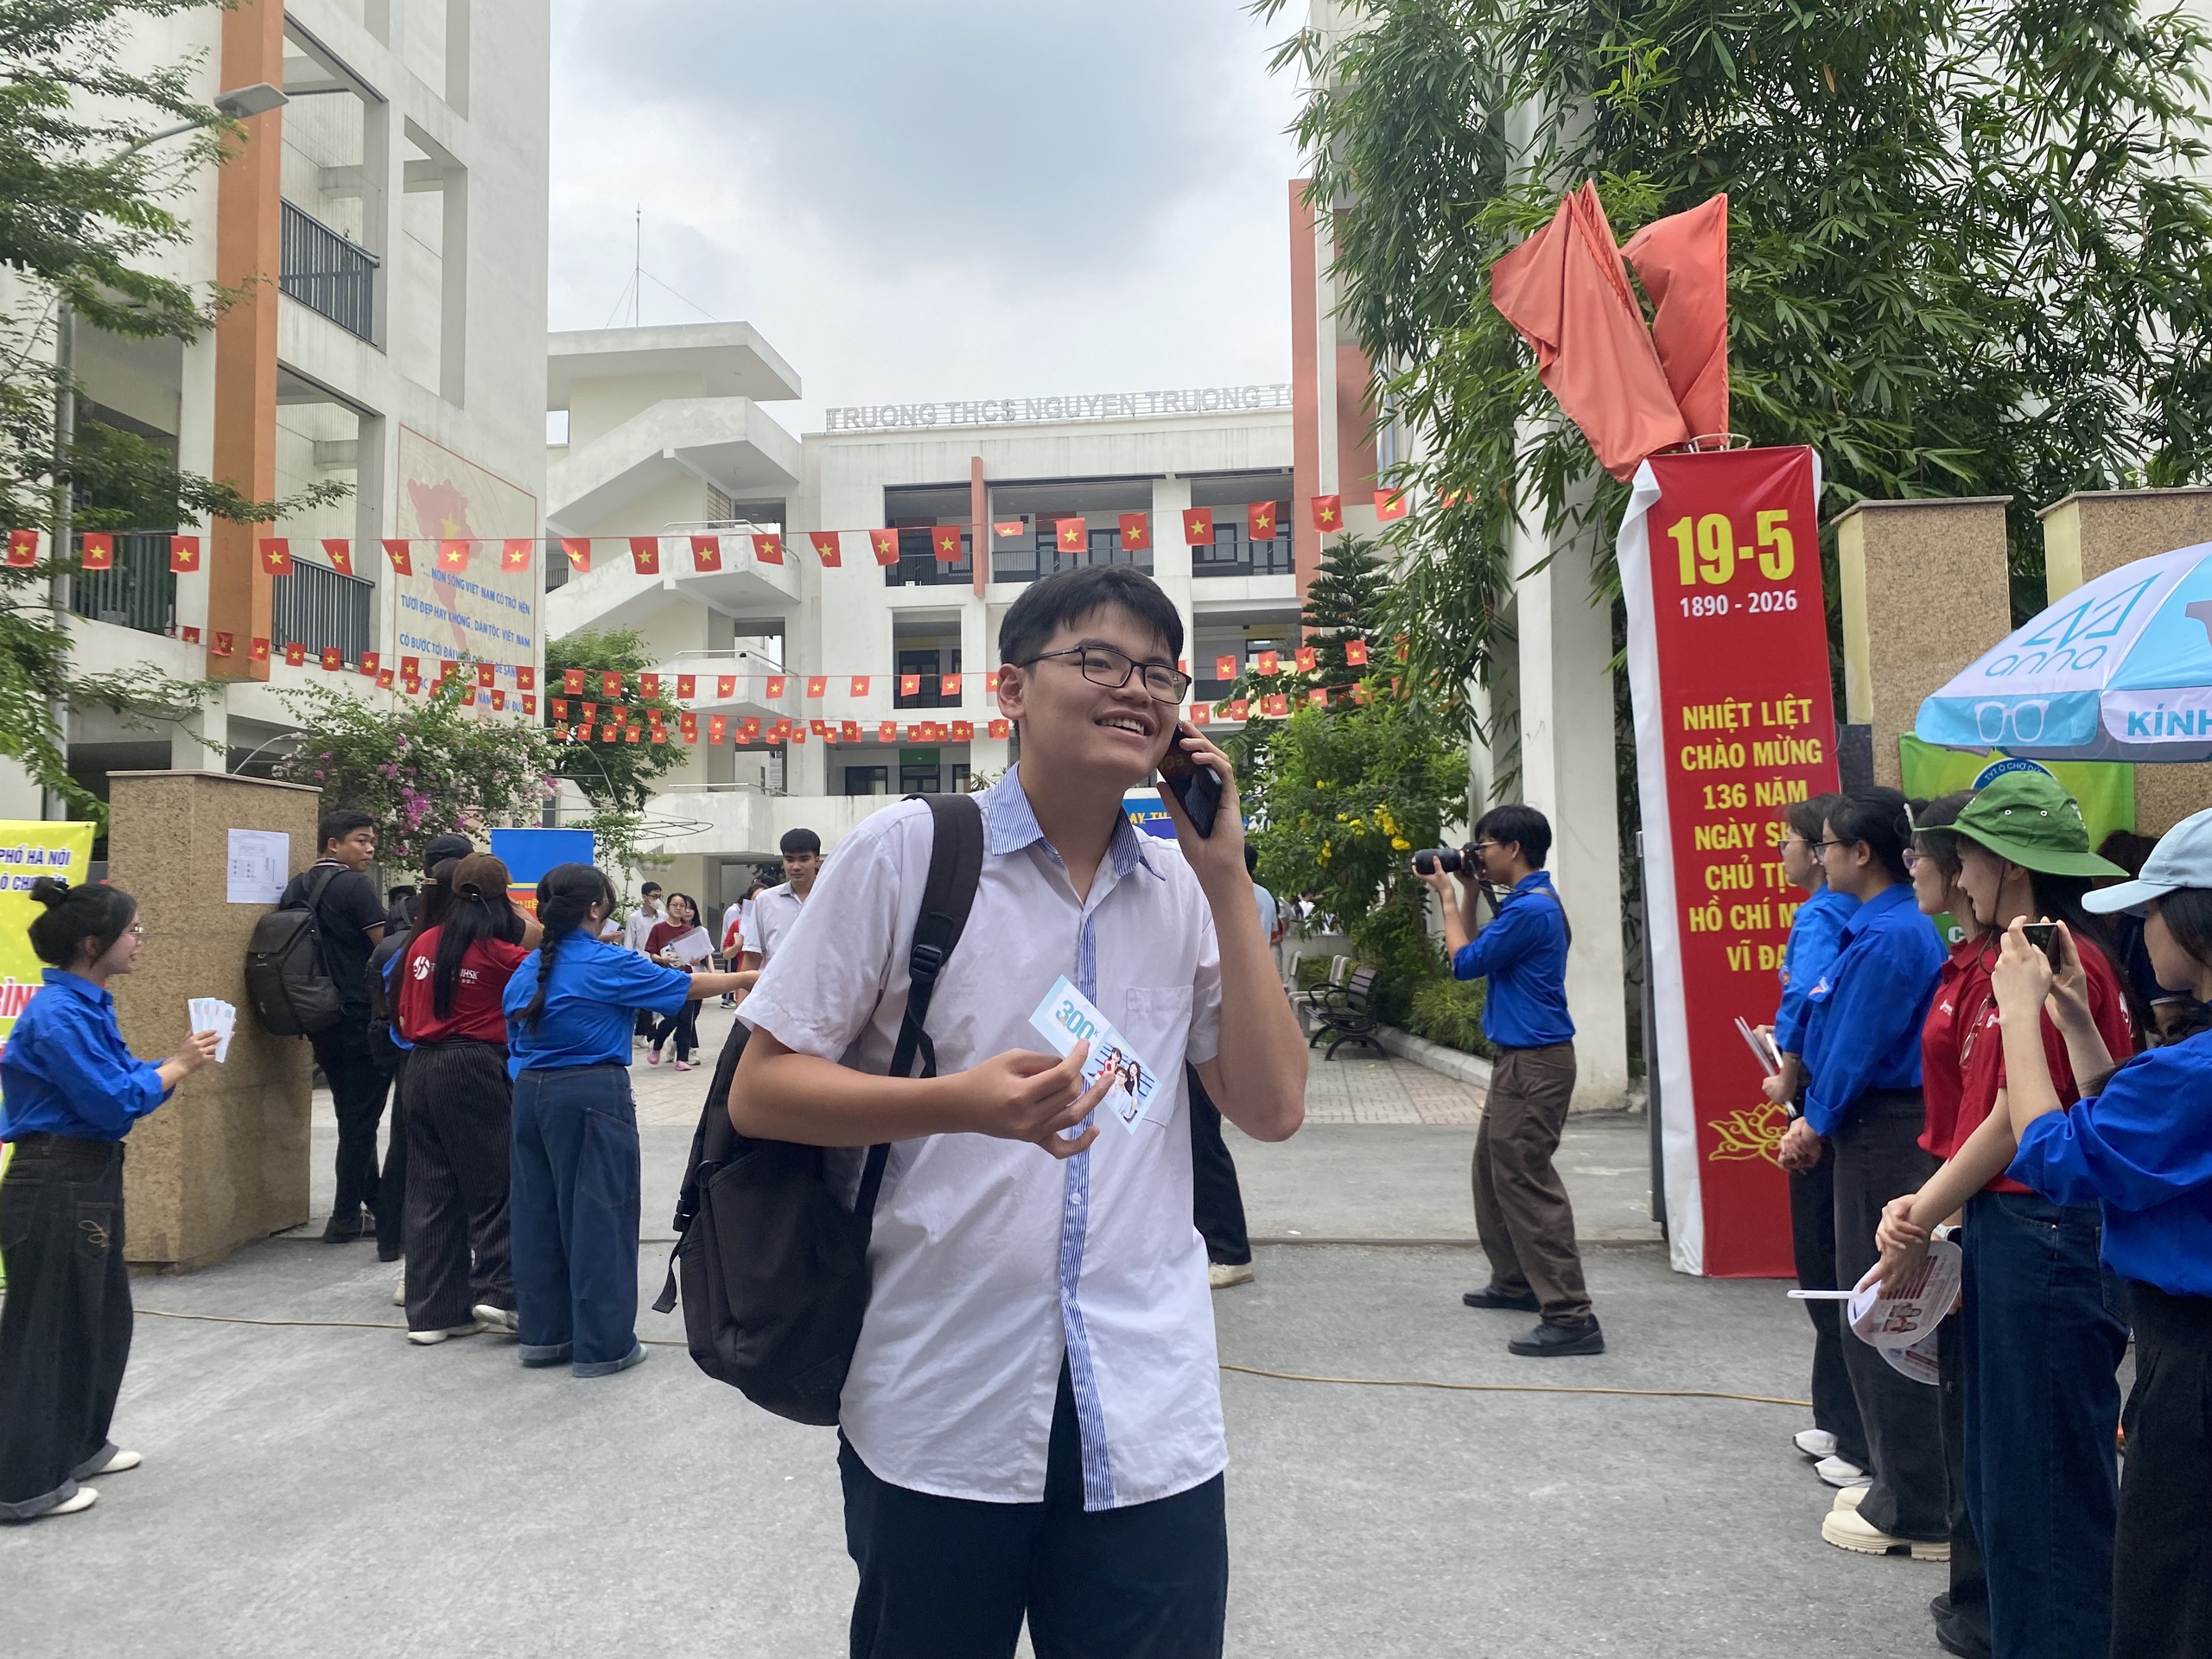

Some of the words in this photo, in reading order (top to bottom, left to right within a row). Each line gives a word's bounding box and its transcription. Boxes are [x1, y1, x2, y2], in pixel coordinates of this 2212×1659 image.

[826, 403, 937, 429] TRUONG
[945, 399, 1016, 423] THCS
[1026, 393, 1135, 419] NGUYEN
[1145, 385, 1260, 413] TRUONG
[1668, 509, 1795, 586] 19-5
[481, 587, 495, 602] NAM
[1680, 594, 1728, 617] 1890
[1747, 589, 1797, 613] 2026
[434, 607, 447, 620] HAY
[517, 634, 531, 648] NAM
[1985, 645, 2107, 677] anna
[1682, 696, 1752, 734] NHIỆT
[1761, 693, 1813, 730] LIỆT
[1681, 738, 1745, 771] CHÀO
[1753, 734, 1823, 767] MỪNG
[1703, 784, 1747, 810] 136
[1755, 776, 1808, 808] NĂM
[1694, 817, 1757, 851] NGÀY
[27, 847, 43, 864] HÀ
[48, 848, 71, 868] NỘI
[1705, 855, 1753, 892] CHỦ
[1688, 895, 1723, 932] HỒ
[1730, 896, 1771, 931] CHÍ
[1726, 940, 1751, 971] VĨ
